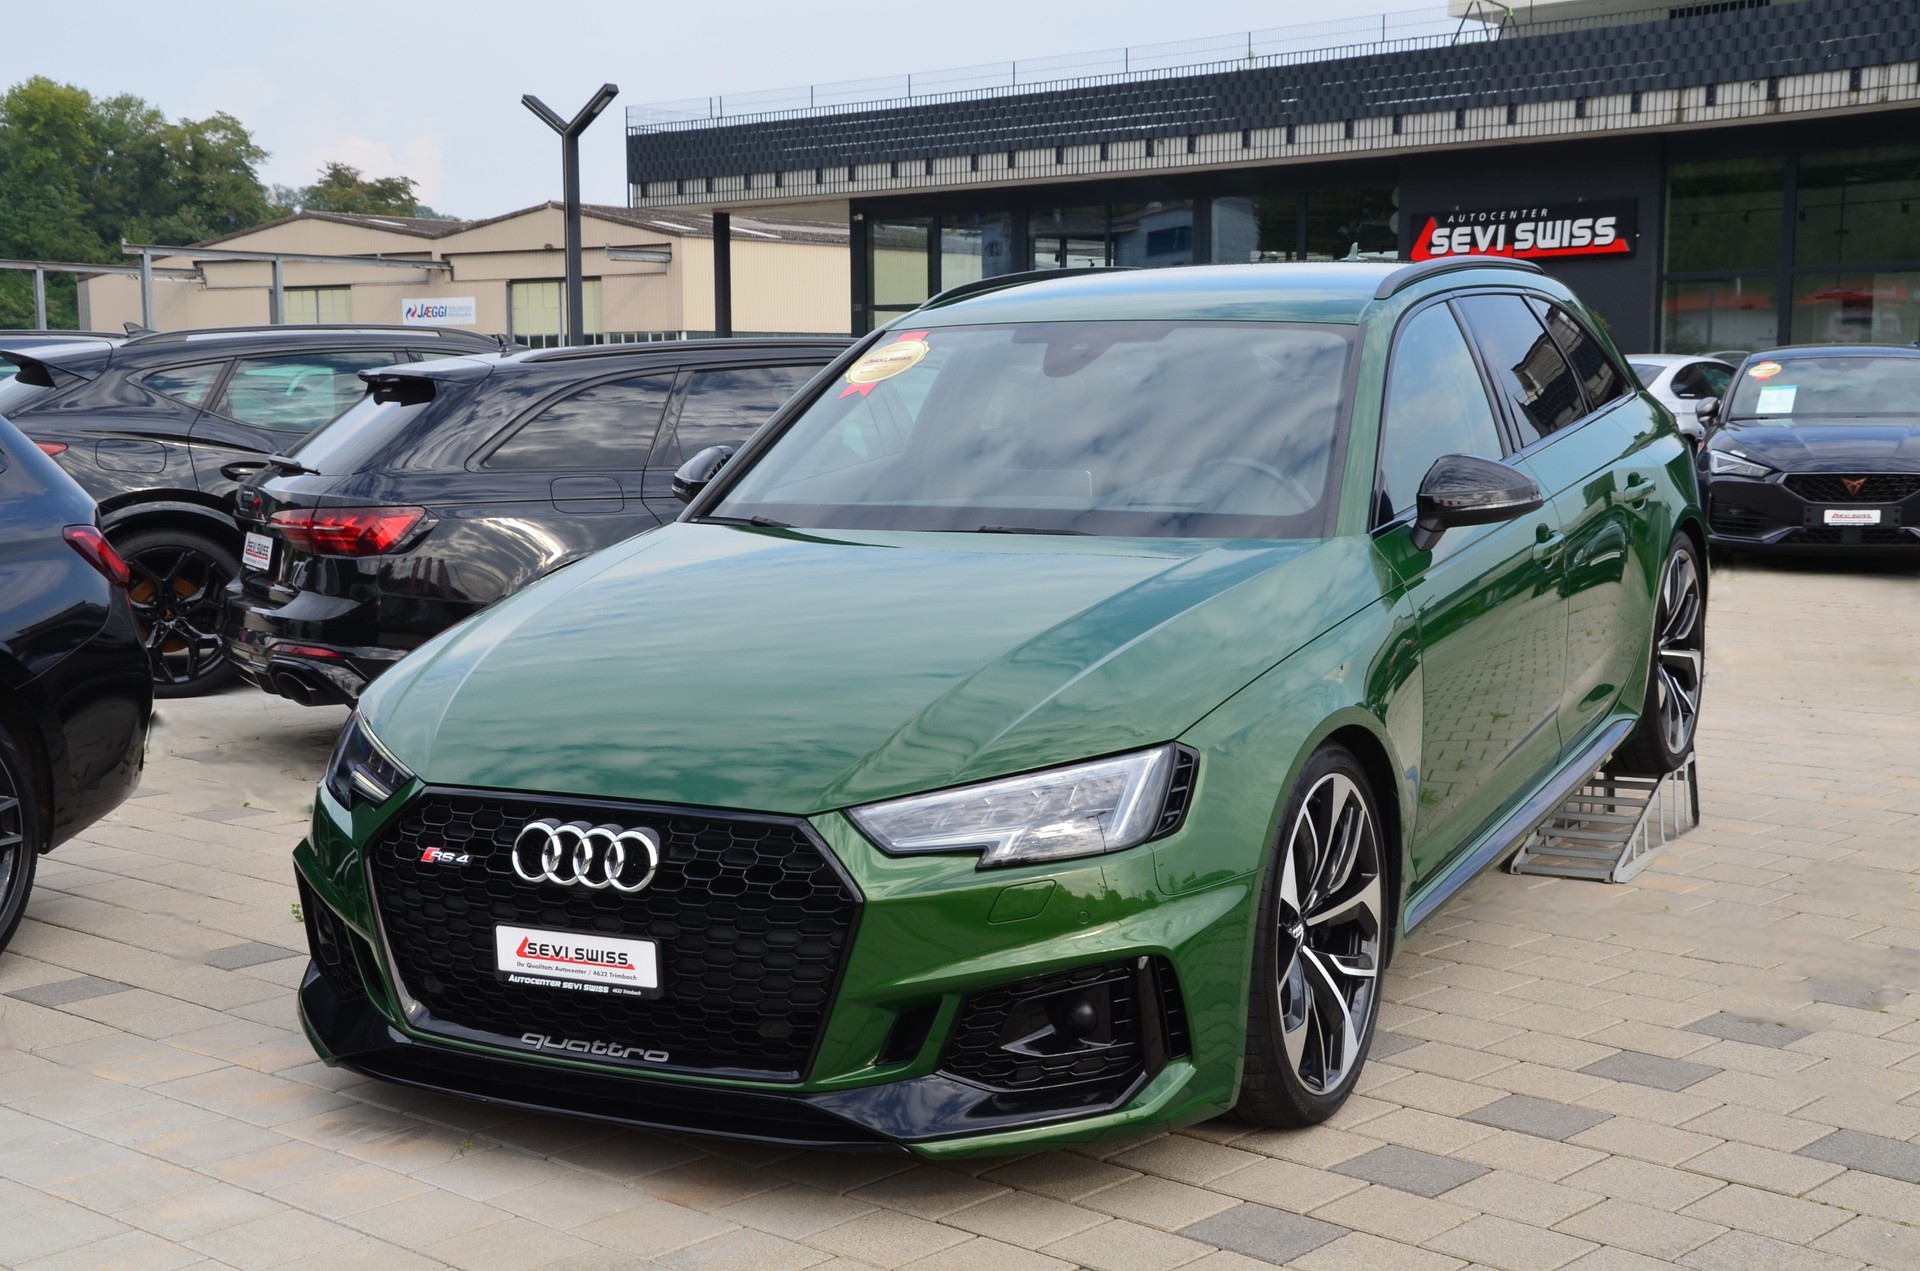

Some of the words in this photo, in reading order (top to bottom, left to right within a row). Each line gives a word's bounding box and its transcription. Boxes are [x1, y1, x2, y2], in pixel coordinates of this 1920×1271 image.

[1447, 208, 1549, 224] AUTOCENTER
[1430, 224, 1506, 255] SEVI
[1513, 216, 1616, 250] SWISS
[527, 942, 569, 959] SEVI
[574, 947, 628, 966] SWISS
[554, 966, 587, 976] Autocenter
[593, 970, 608, 978] 4632
[609, 971, 637, 981] Trimbach
[562, 981, 583, 991] SEVI
[583, 983, 610, 994] SWISS
[520, 1032, 670, 1063] quattro
